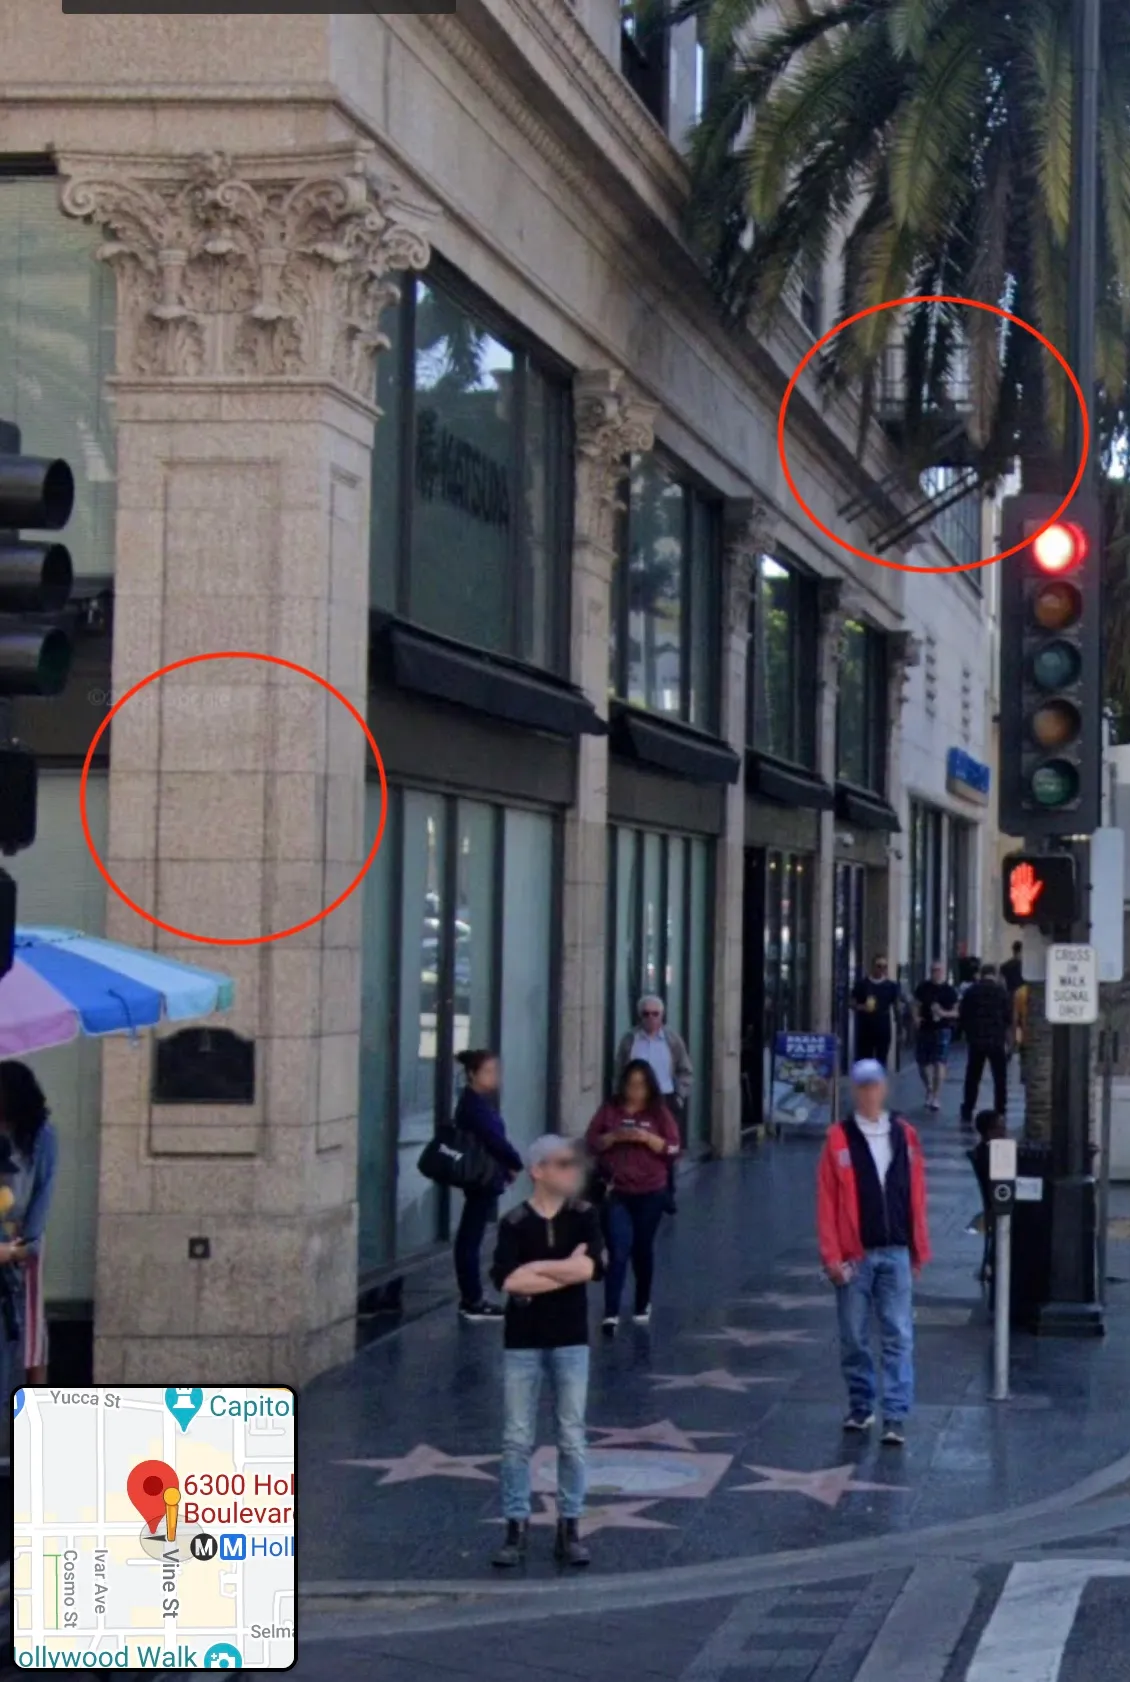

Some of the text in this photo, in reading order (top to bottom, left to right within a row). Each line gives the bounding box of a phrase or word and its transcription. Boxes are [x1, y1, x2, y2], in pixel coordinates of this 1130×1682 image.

[1055, 949, 1090, 961] CROSS
[1067, 963, 1078, 973] IN
[1058, 976, 1085, 987] WALK
[1053, 990, 1089, 1002] SIGNAL
[1058, 1004, 1085, 1017] ONLY
